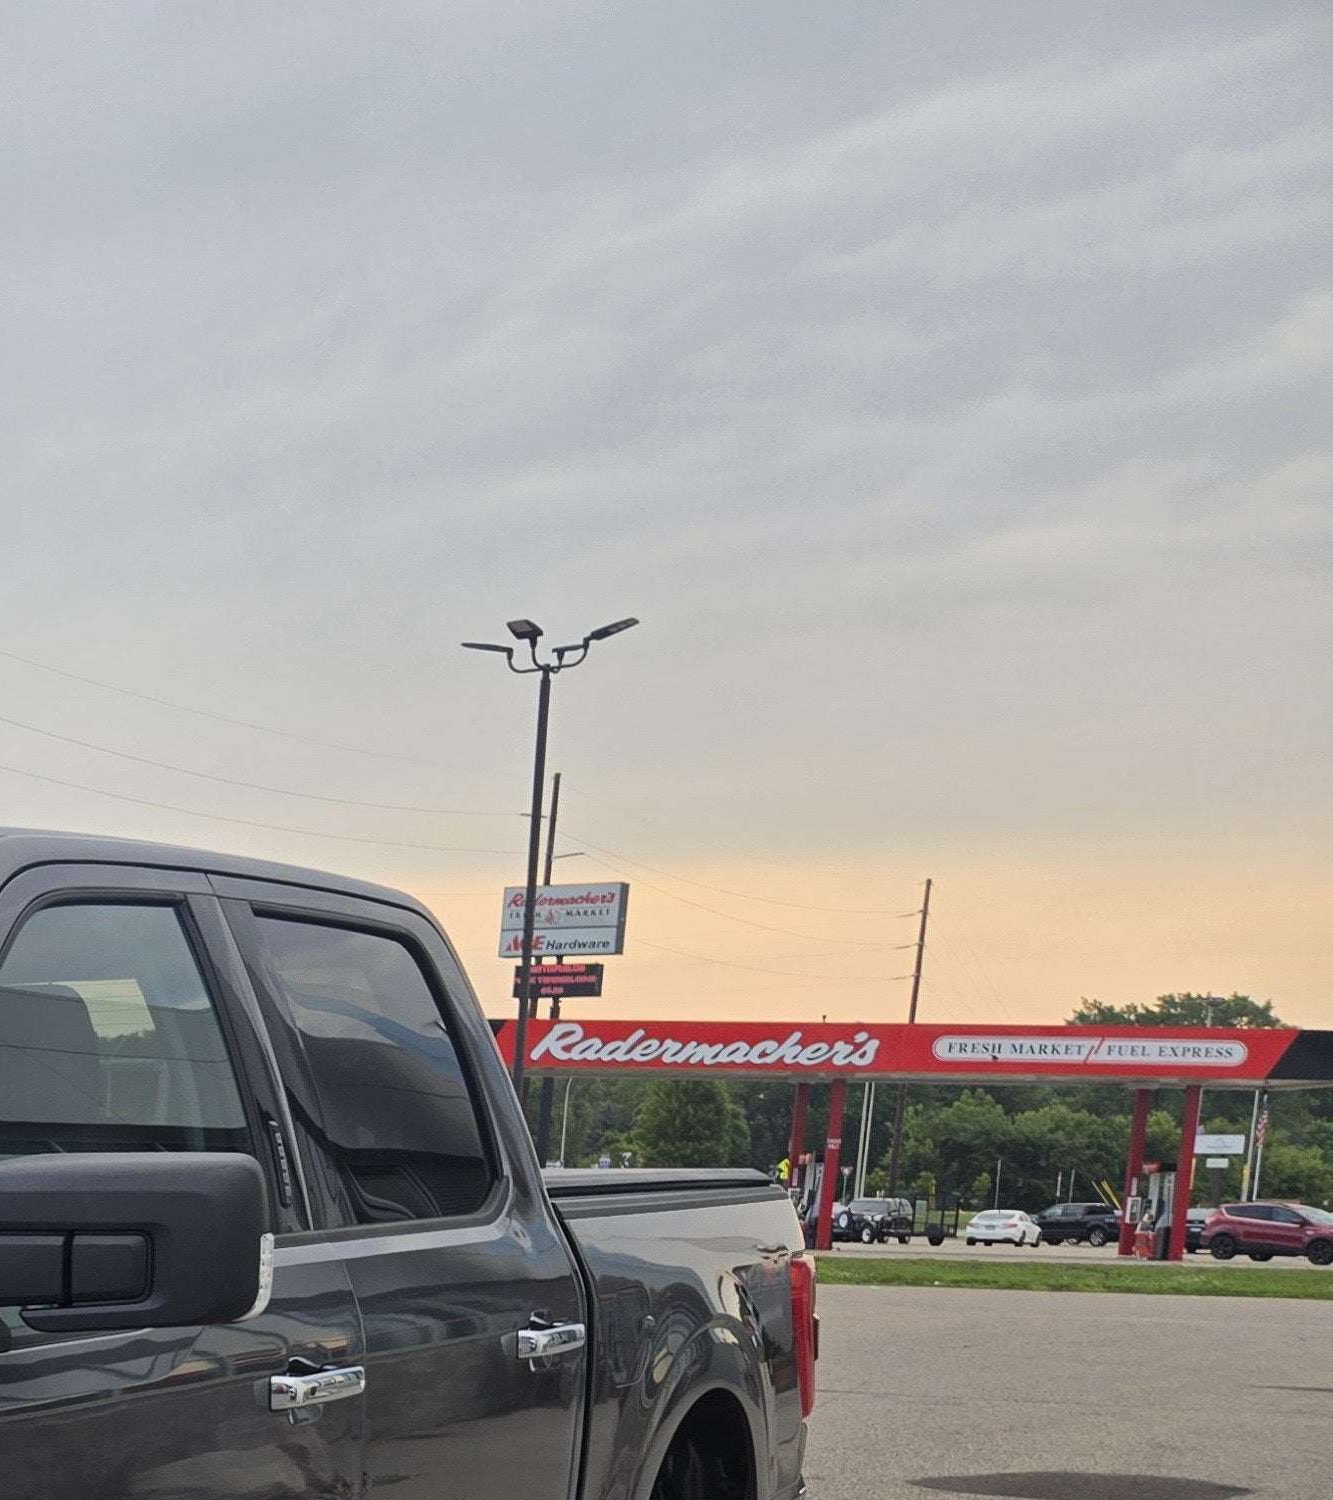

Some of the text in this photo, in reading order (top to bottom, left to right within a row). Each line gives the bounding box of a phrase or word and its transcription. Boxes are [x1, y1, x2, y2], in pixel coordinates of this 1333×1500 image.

[565, 908, 611, 917] MARKET
[505, 934, 610, 952] AE Hardware
[530, 1022, 881, 1066] Radermacher's
[947, 1041, 1085, 1056] FRESH MARKET
[1106, 1044, 1234, 1059] FUEL EXPRESS
